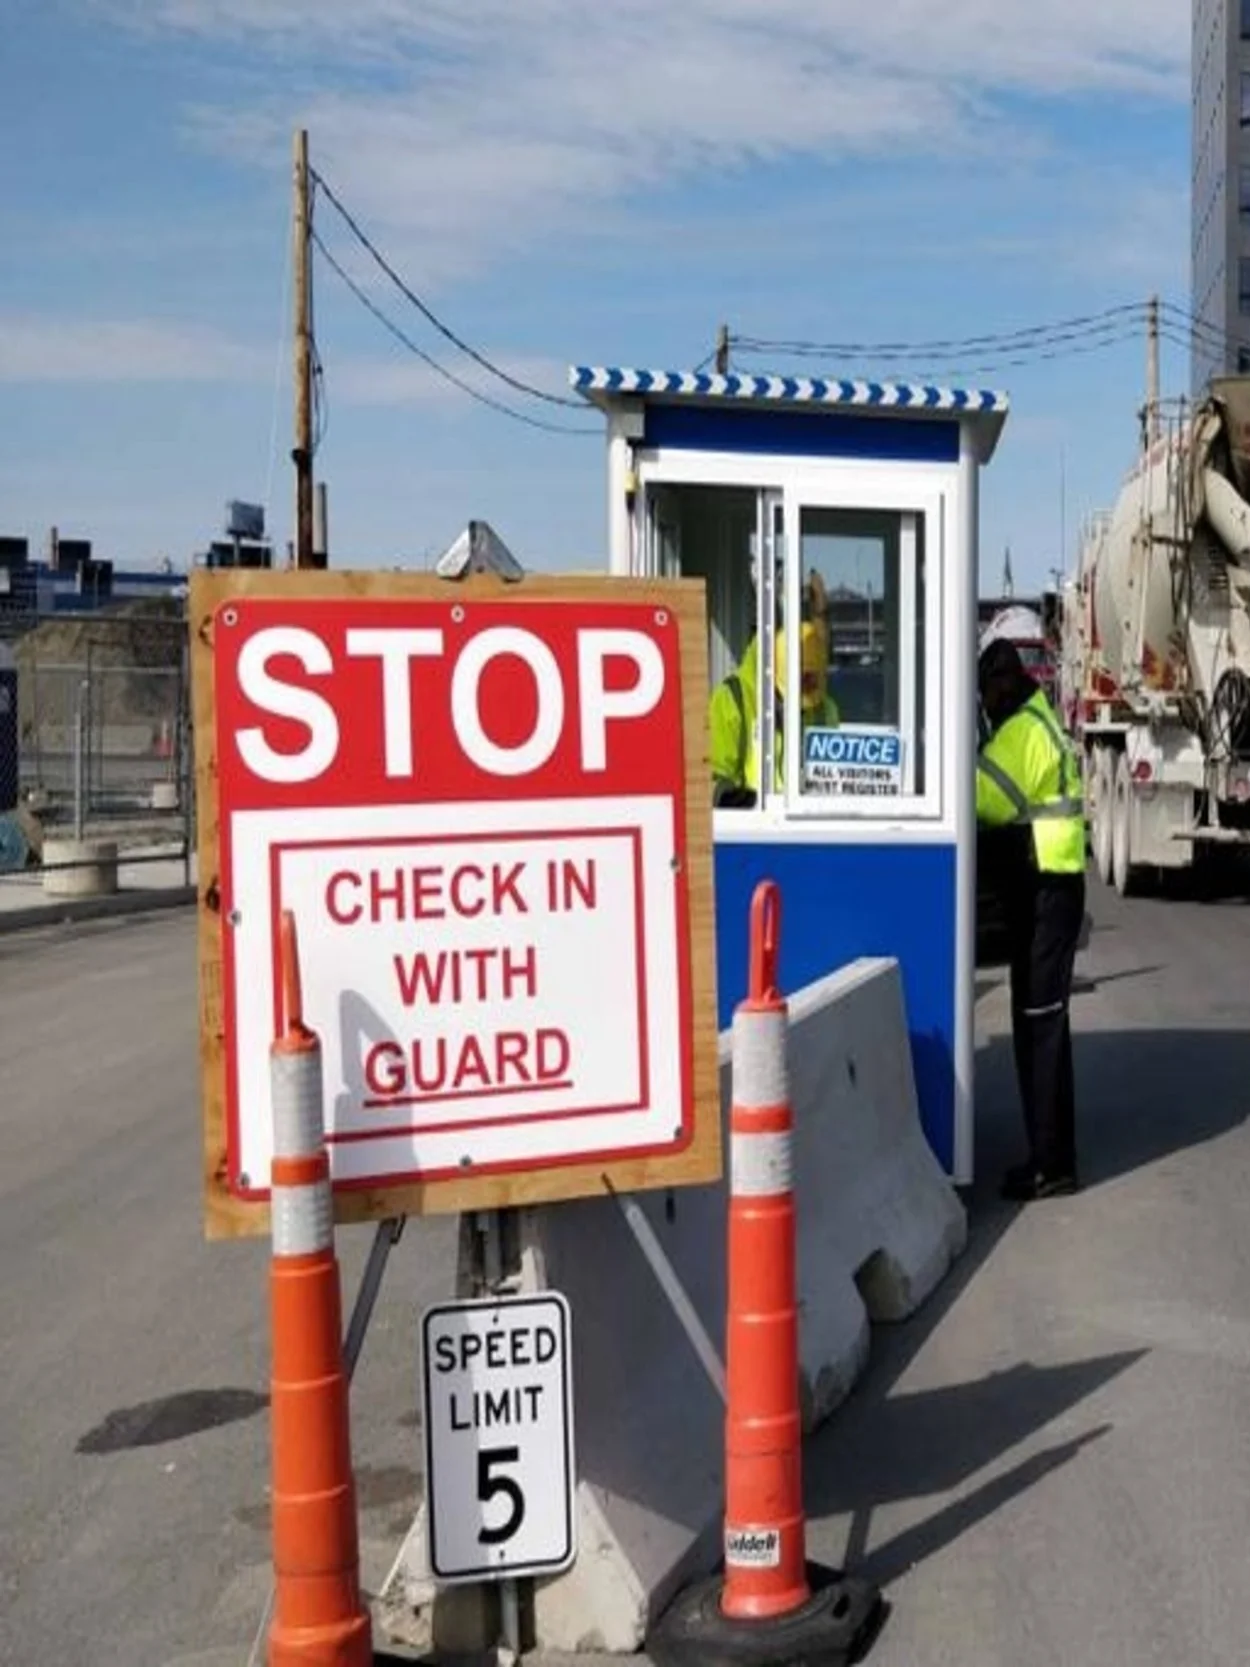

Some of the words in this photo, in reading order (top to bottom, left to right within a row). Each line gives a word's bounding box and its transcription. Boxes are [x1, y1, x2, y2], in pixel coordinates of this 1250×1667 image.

[235, 625, 665, 783] STOP
[809, 734, 897, 763] NOTICE
[812, 765, 834, 779] ALL
[324, 861, 529, 926] CHECK
[547, 858, 597, 912] IN
[393, 946, 539, 1007] WITH
[363, 1027, 572, 1096] GUARD
[434, 1326, 558, 1373] SPEED
[450, 1385, 544, 1432] LIMIT
[477, 1445, 526, 1545] 5
